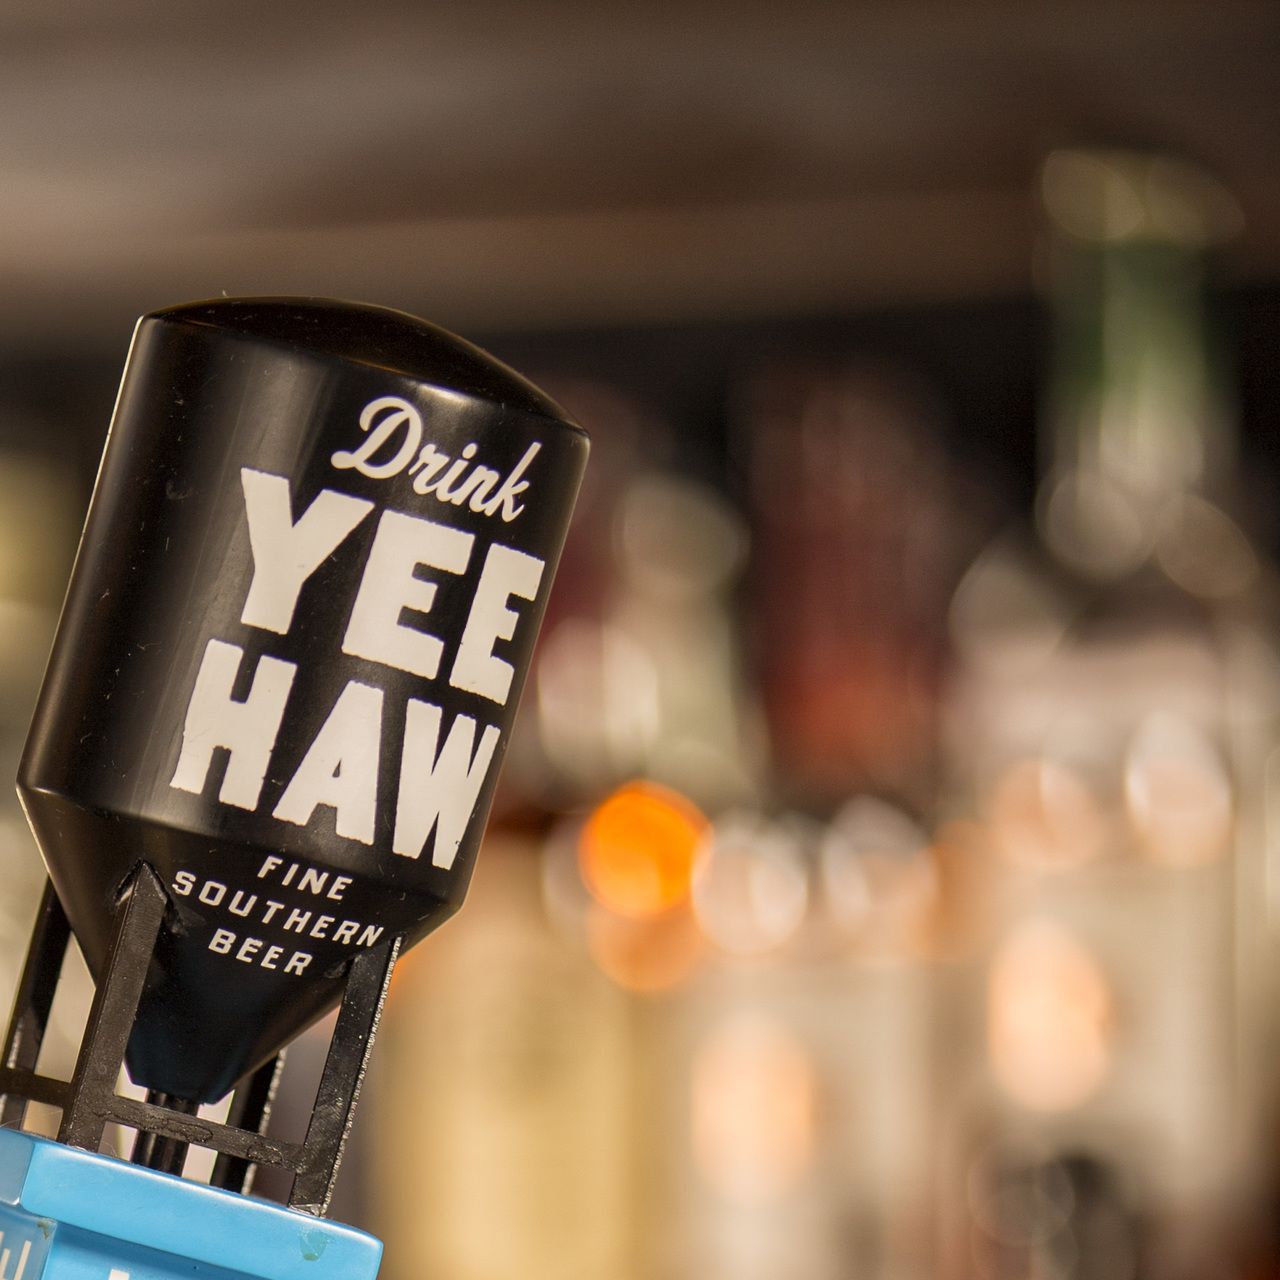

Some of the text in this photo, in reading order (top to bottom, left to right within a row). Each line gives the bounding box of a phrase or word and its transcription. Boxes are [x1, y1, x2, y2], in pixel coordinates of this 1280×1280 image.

[331, 396, 542, 524] Drink
[240, 466, 546, 706] YEE
[169, 638, 502, 871] HAW
[171, 869, 384, 949] SOUTHERN
[256, 856, 354, 902] FINE
[207, 926, 314, 976] BEER
